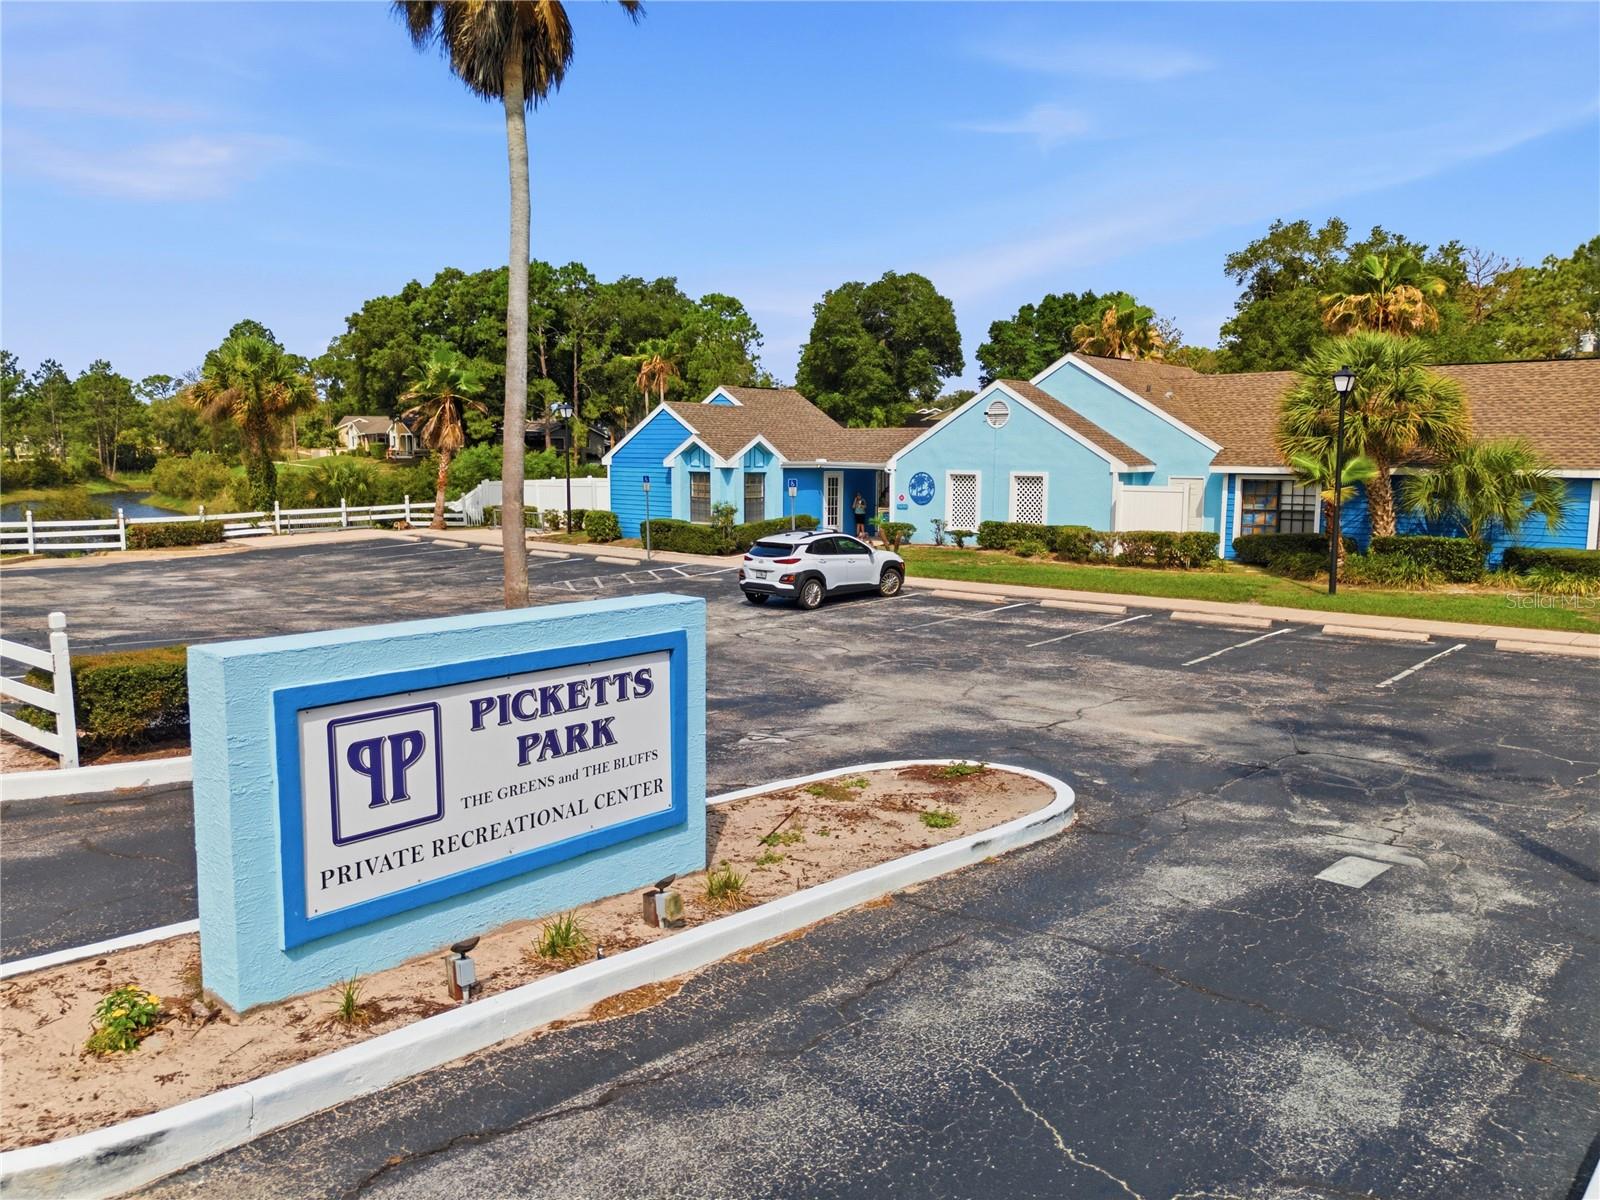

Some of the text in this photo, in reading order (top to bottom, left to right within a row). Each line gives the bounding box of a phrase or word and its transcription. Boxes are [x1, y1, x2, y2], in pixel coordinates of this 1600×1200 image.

[470, 668, 655, 731] PICKETTS
[517, 716, 618, 767] PARK
[460, 749, 659, 810] THE GREENS and THE BLUFFS
[320, 778, 664, 891] PRIVATE RECREATIONAL CENTER
